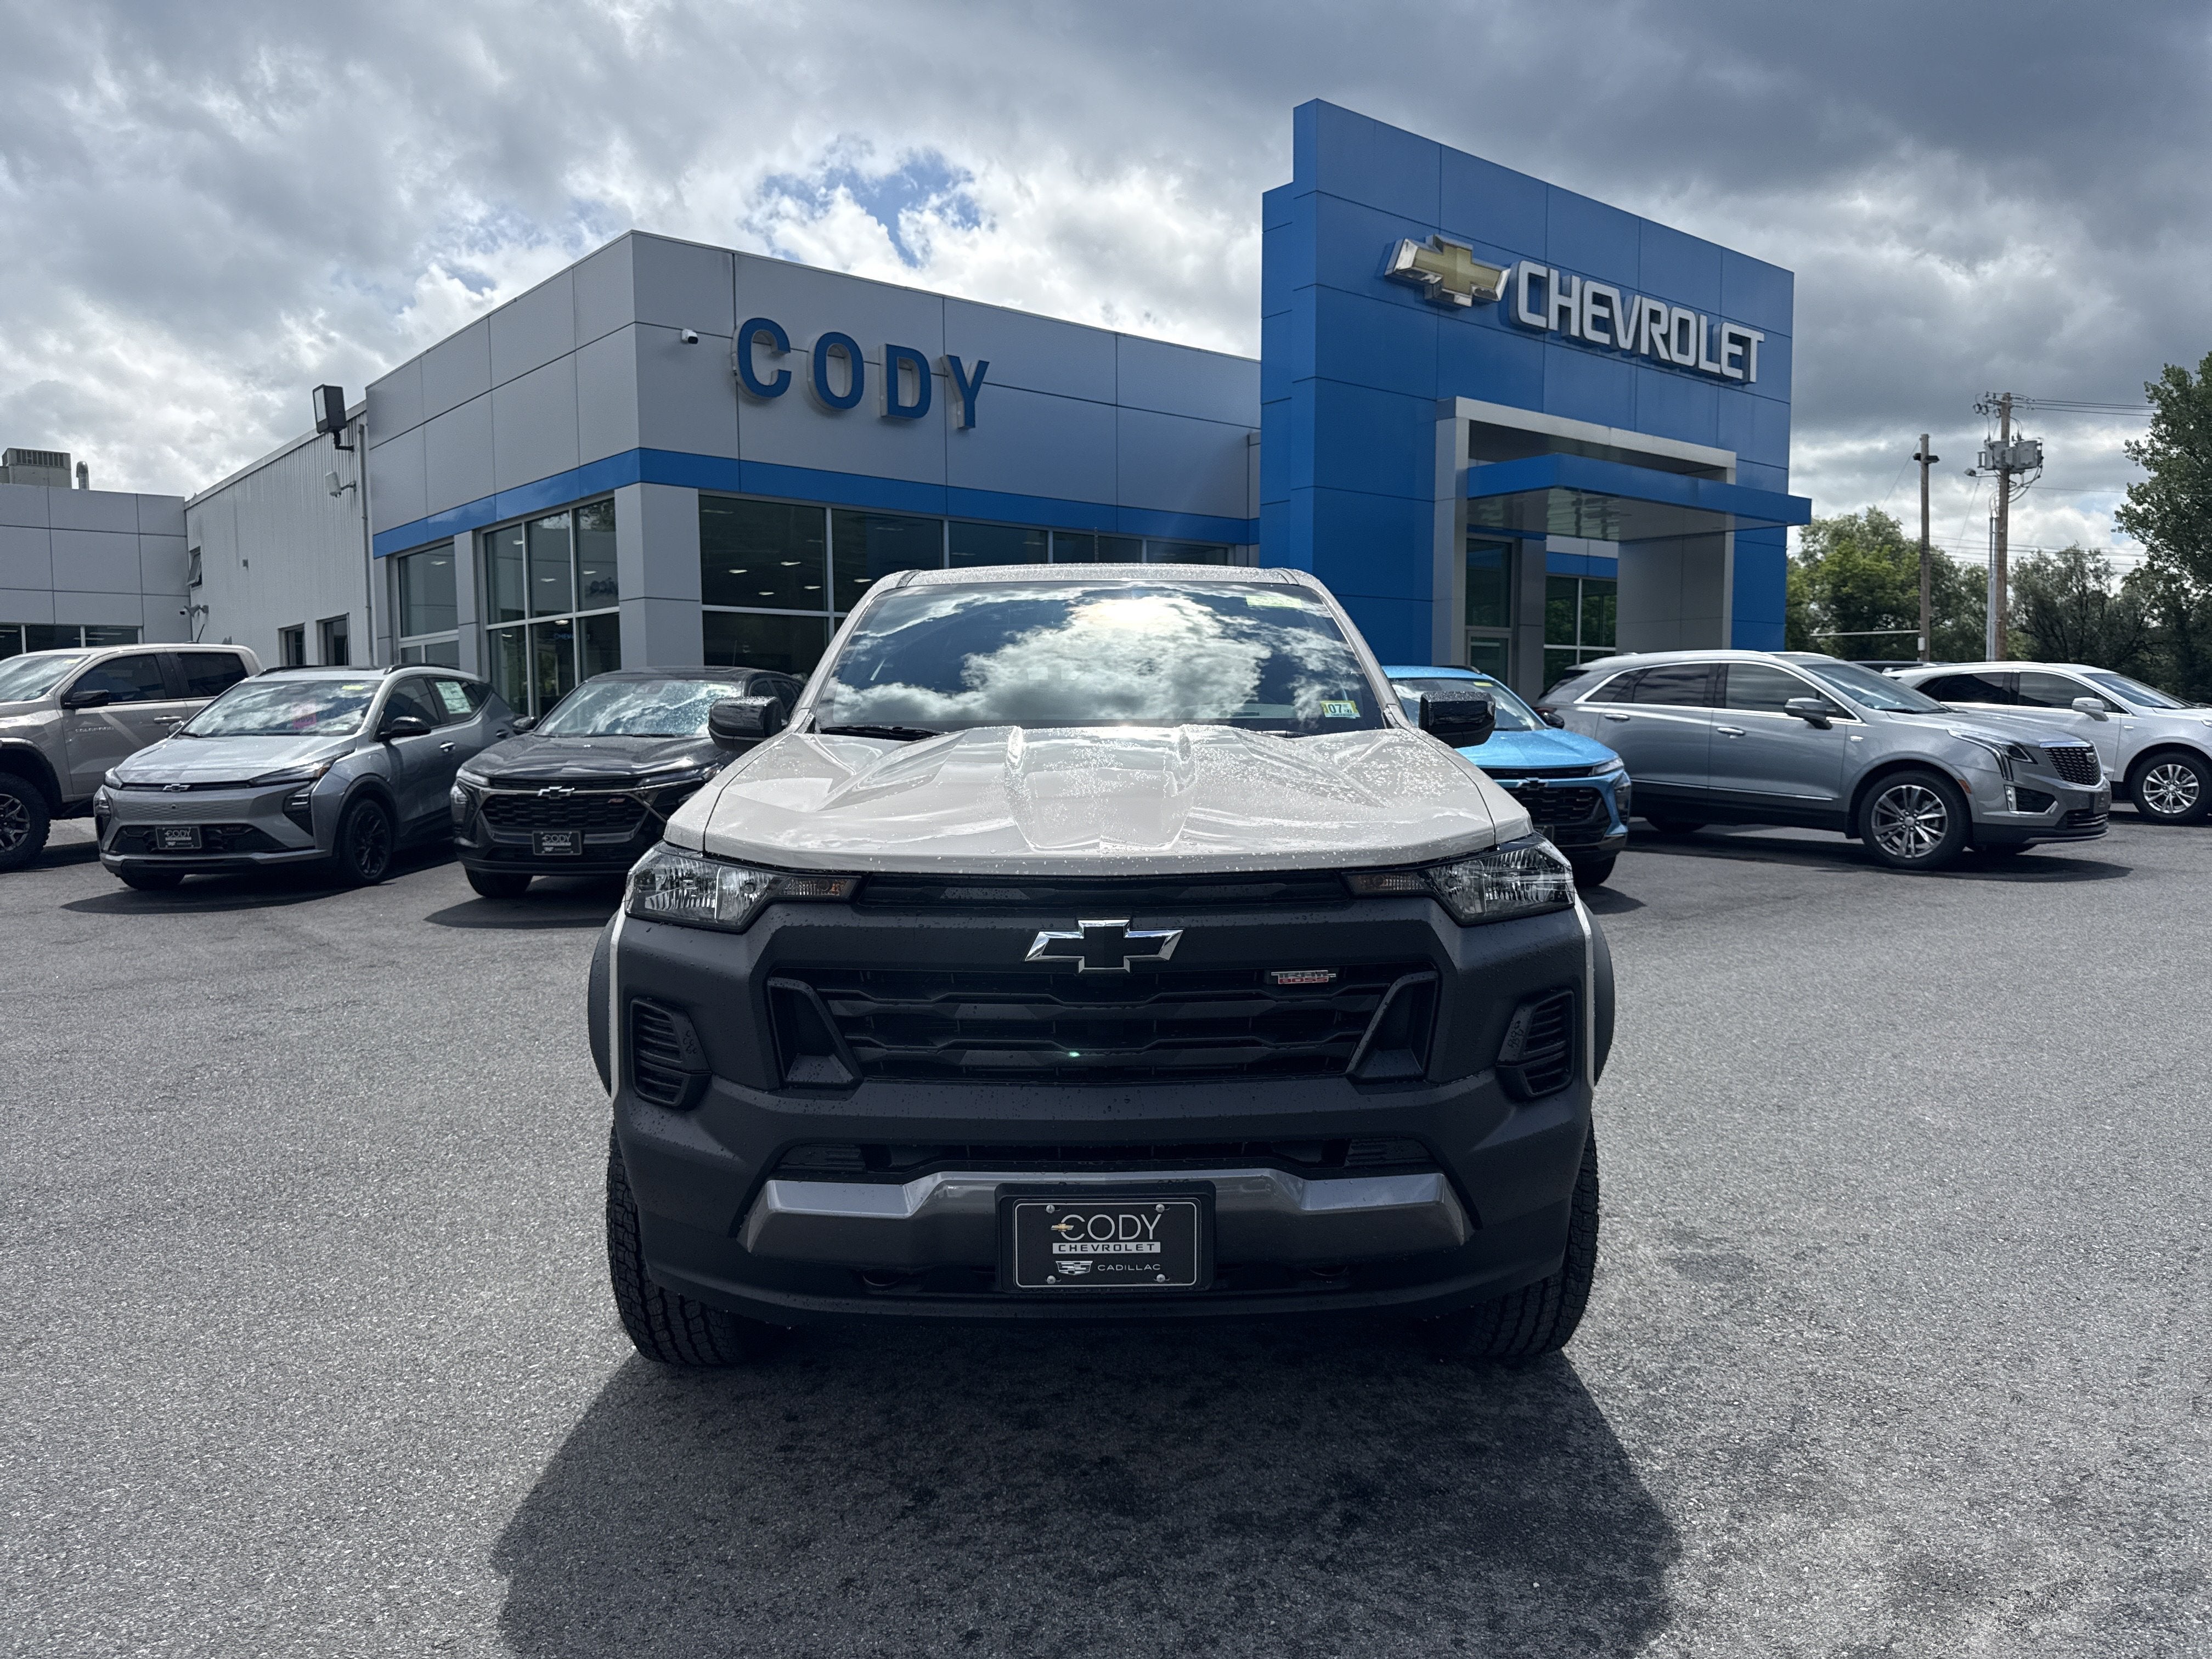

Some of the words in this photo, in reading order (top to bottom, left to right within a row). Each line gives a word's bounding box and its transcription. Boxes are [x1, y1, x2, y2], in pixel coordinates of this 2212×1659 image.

[1510, 260, 1764, 383] CHEVROLET
[732, 317, 990, 430] CODY
[1328, 704, 1342, 714] 07
[544, 834, 571, 842] CODY
[1060, 1214, 1162, 1241] CODY
[1058, 1244, 1155, 1252] CHEVROLET
